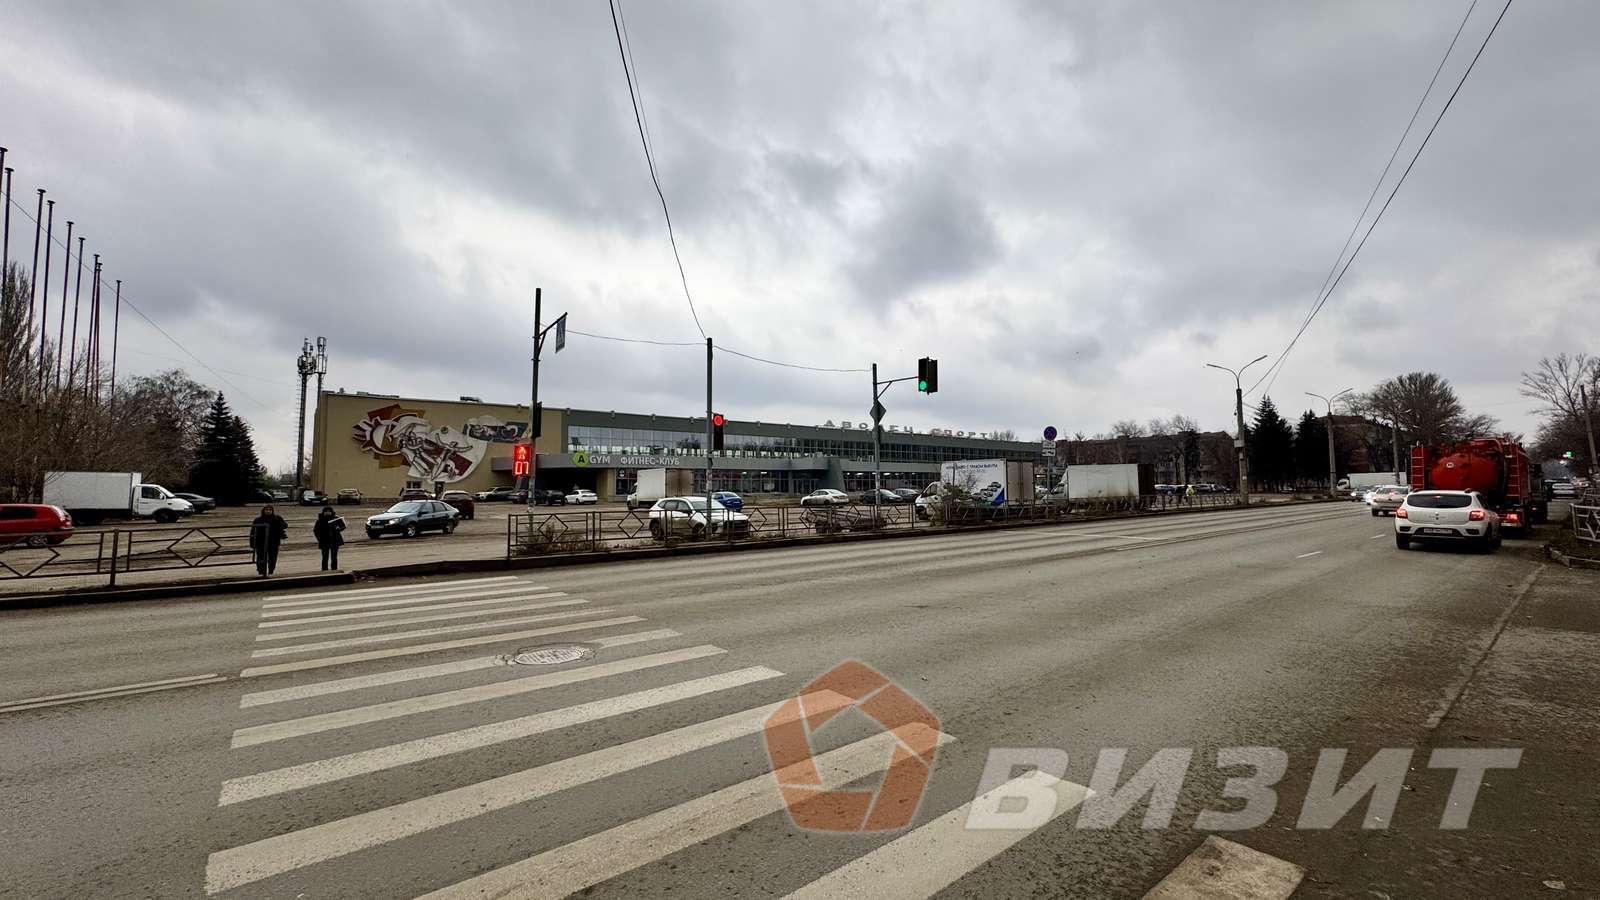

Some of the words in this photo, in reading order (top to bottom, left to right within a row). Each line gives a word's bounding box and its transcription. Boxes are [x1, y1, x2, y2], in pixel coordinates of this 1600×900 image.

[823, 419, 914, 434] ДВОЕЦ
[589, 455, 611, 465] GYM
[620, 456, 681, 466] ФИТНЕС-КЛУБ
[514, 461, 529, 475] 07
